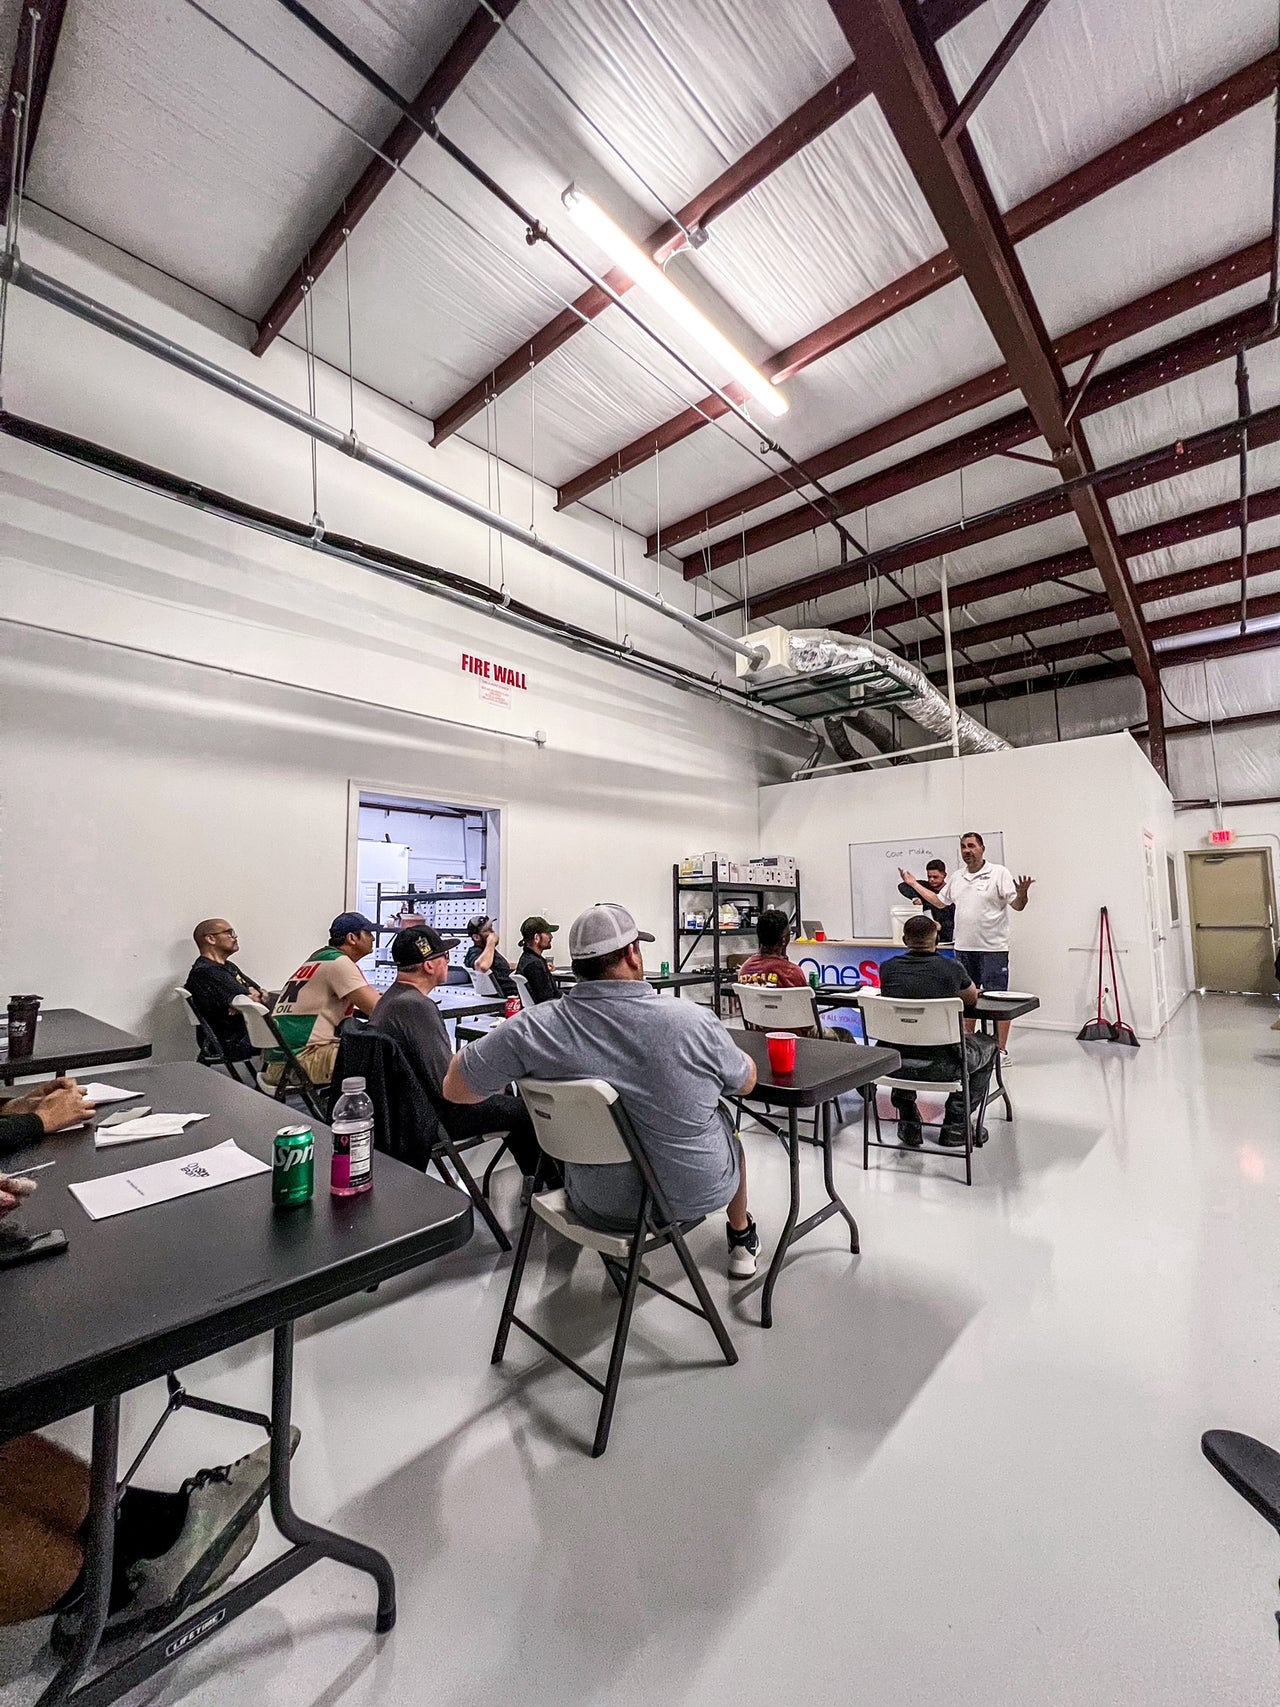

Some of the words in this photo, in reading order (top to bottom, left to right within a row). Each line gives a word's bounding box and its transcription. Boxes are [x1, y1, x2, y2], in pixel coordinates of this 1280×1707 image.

[461, 653, 490, 679] FIRE
[493, 664, 528, 690] WALL
[1212, 830, 1231, 843] EXIT
[276, 1004, 293, 1014] OIL
